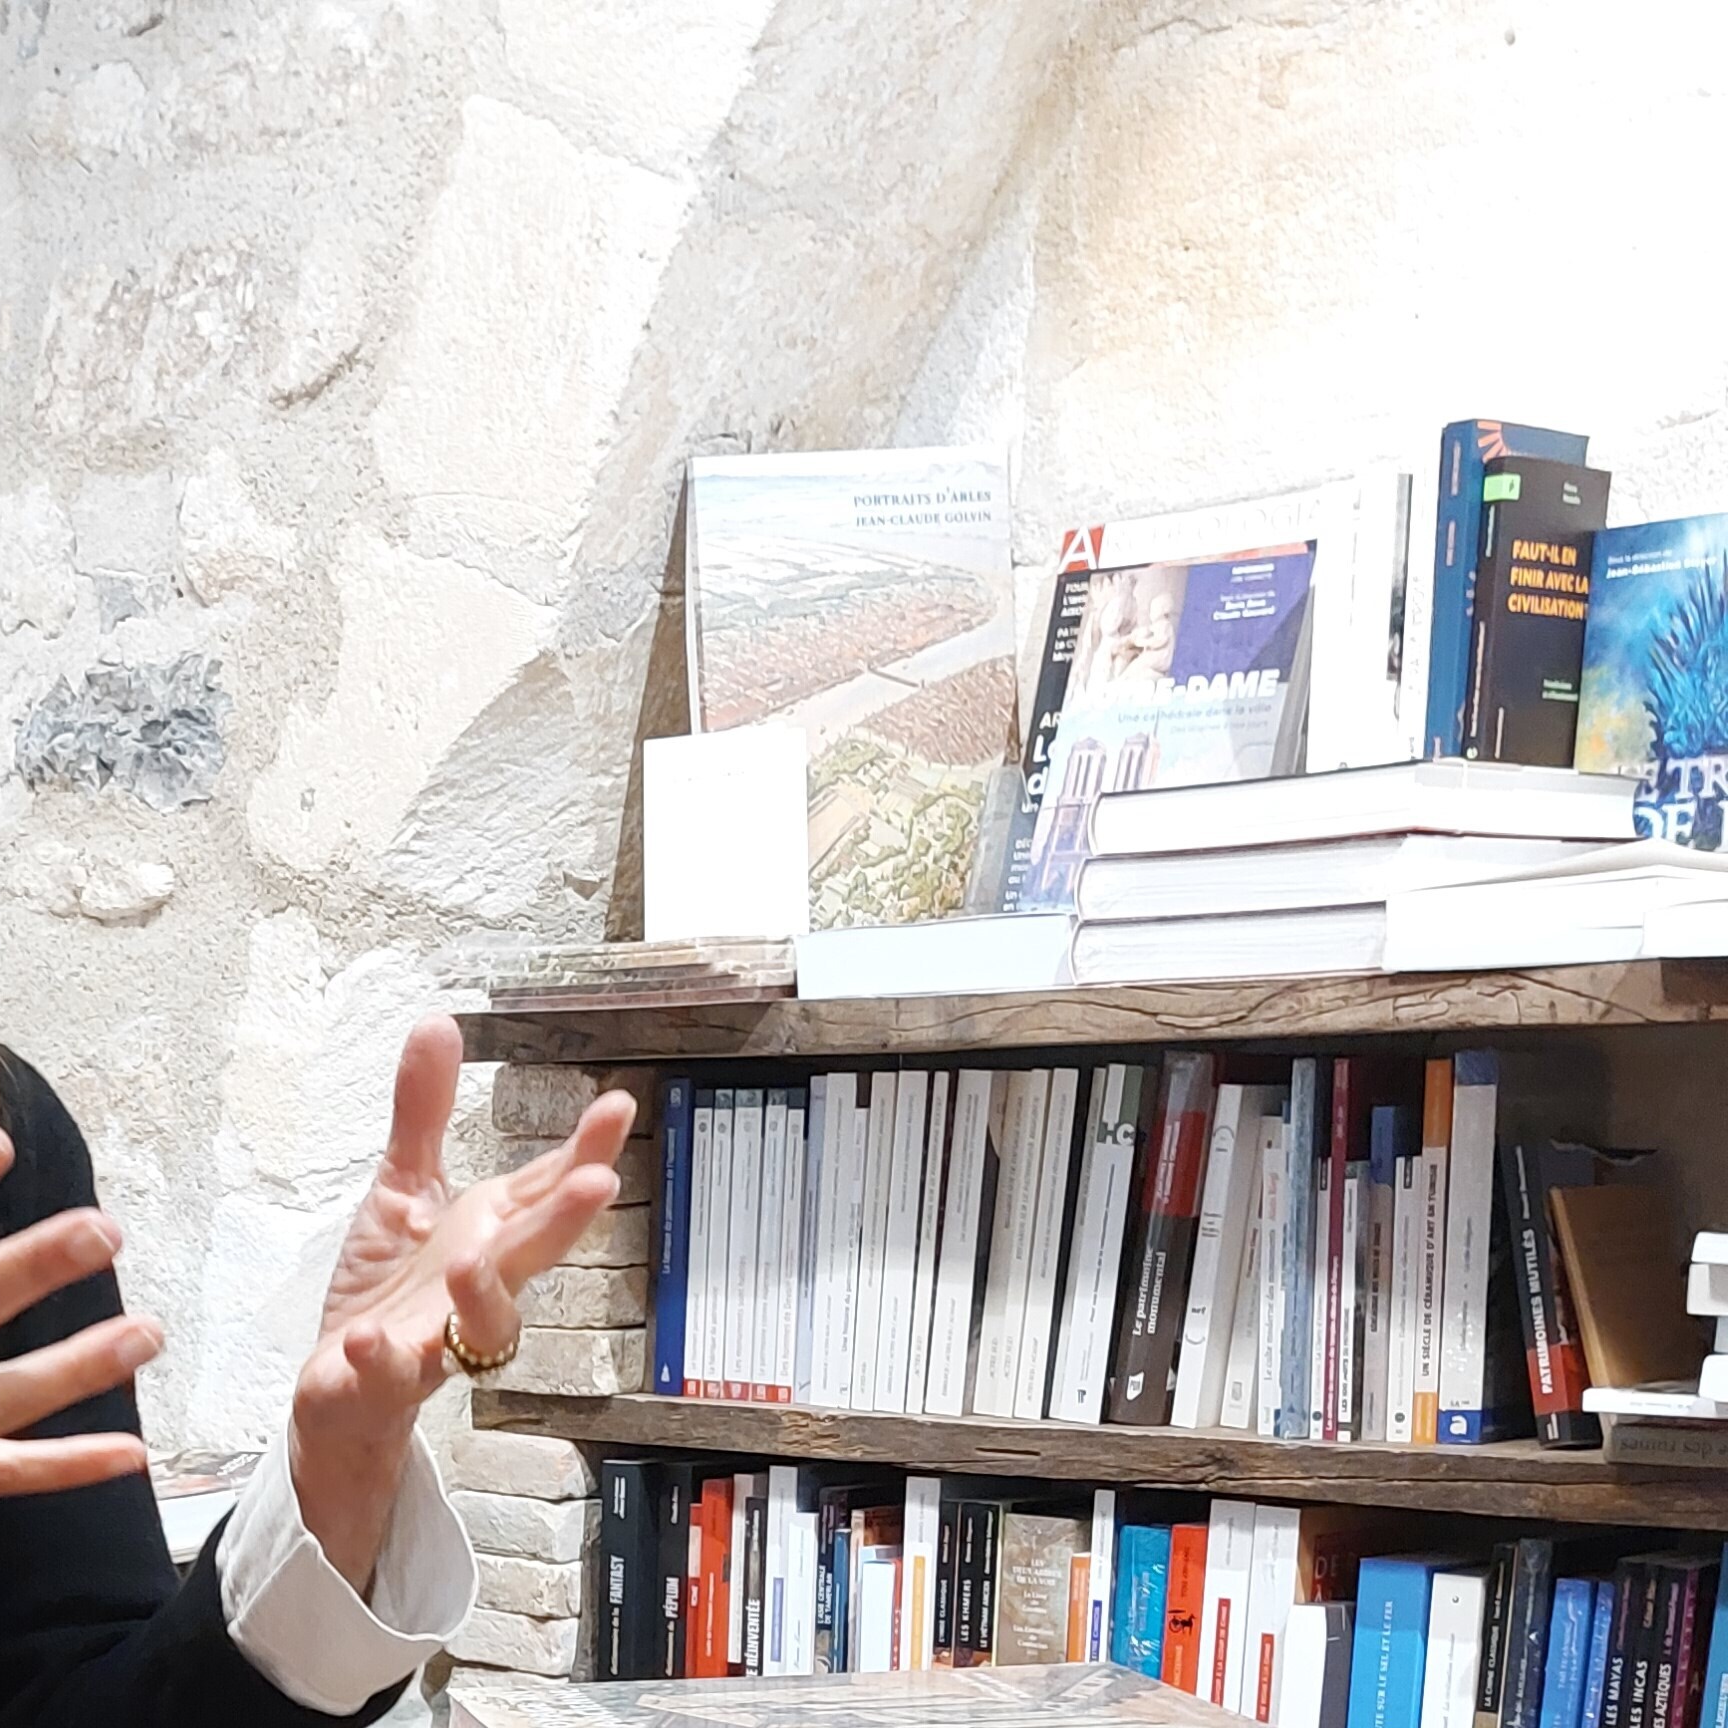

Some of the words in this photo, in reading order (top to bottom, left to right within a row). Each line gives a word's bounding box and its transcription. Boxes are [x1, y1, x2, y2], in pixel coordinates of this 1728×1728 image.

[853, 493, 930, 507] PORTRAITS
[936, 486, 991, 504] D'ARLES
[856, 512, 940, 526] JEAN-CLAUDE
[944, 511, 991, 523] GOLVIN
[1512, 538, 1560, 565] FAUT-IL
[1561, 546, 1576, 566] EN
[1510, 566, 1544, 588] FINIR
[1545, 572, 1574, 592] AVEC
[1575, 576, 1588, 594] LA
[1507, 593, 1583, 619] CIVILISATION
[1424, 1221, 1436, 1249] D'ART
[1518, 1227, 1541, 1294] MUTILÉS
[1135, 1246, 1154, 1318] patrimoine
[1145, 1250, 1167, 1334] monumental
[1421, 1252, 1435, 1308] CÉRAMIQUE
[1132, 1320, 1145, 1335] Le
[1421, 1311, 1433, 1325] DE
[1420, 1327, 1432, 1359] SIÈCLE
[1530, 1294, 1554, 1394] PATRIMOINES
[1419, 1362, 1431, 1375] UN
[608, 1554, 624, 1604] FANTASY
[660, 1576, 679, 1618] PÉPLUM
[961, 1578, 971, 1620] KHMERS
[1383, 1600, 1393, 1619] FER
[743, 1598, 760, 1666] RÉINVENTÉE
[960, 1624, 970, 1641] LES
[1382, 1622, 1391, 1635] LE
[1380, 1639, 1390, 1652] ET
[1379, 1653, 1389, 1671] SEL
[1378, 1674, 1387, 1687] LE
[1607, 1656, 1624, 1700] MAYAS
[1632, 1659, 1649, 1703] INCAS
[1651, 1661, 1672, 1716] AZTÈQUES
[1376, 1689, 1385, 1710] SUR
[1604, 1703, 1618, 1725] LES
